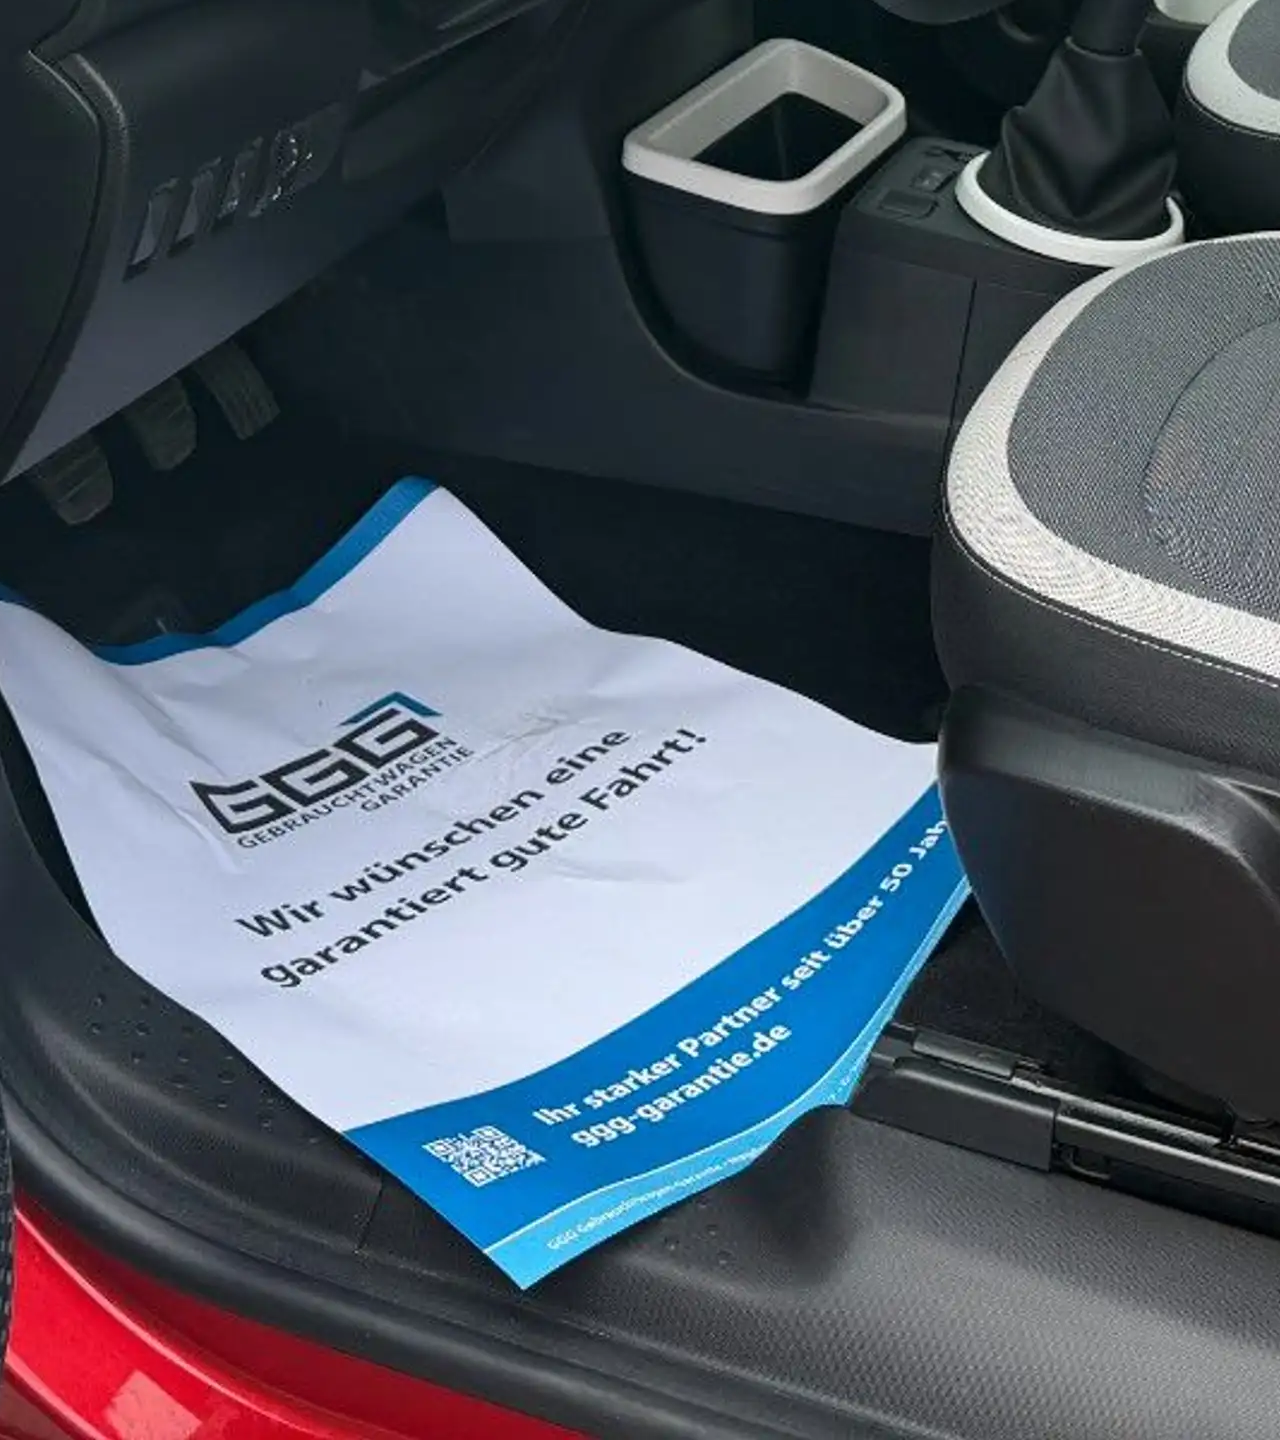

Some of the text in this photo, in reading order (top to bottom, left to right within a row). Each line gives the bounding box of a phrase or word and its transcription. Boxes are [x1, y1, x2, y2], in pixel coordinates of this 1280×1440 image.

[236, 729, 632, 939] Wir wünschen eine
[237, 736, 457, 851] GEBRAUCHTWAGEN
[261, 727, 708, 989] garantiert gute Fahrt!
[360, 745, 475, 813] GARANTIE
[532, 1103, 583, 1127] Ihr
[582, 1051, 683, 1111] starker
[676, 987, 782, 1058] Partner
[781, 949, 833, 991] seit
[823, 894, 885, 950] über
[879, 862, 913, 893] 50
[570, 1024, 793, 1149] ggg-garantie.de
